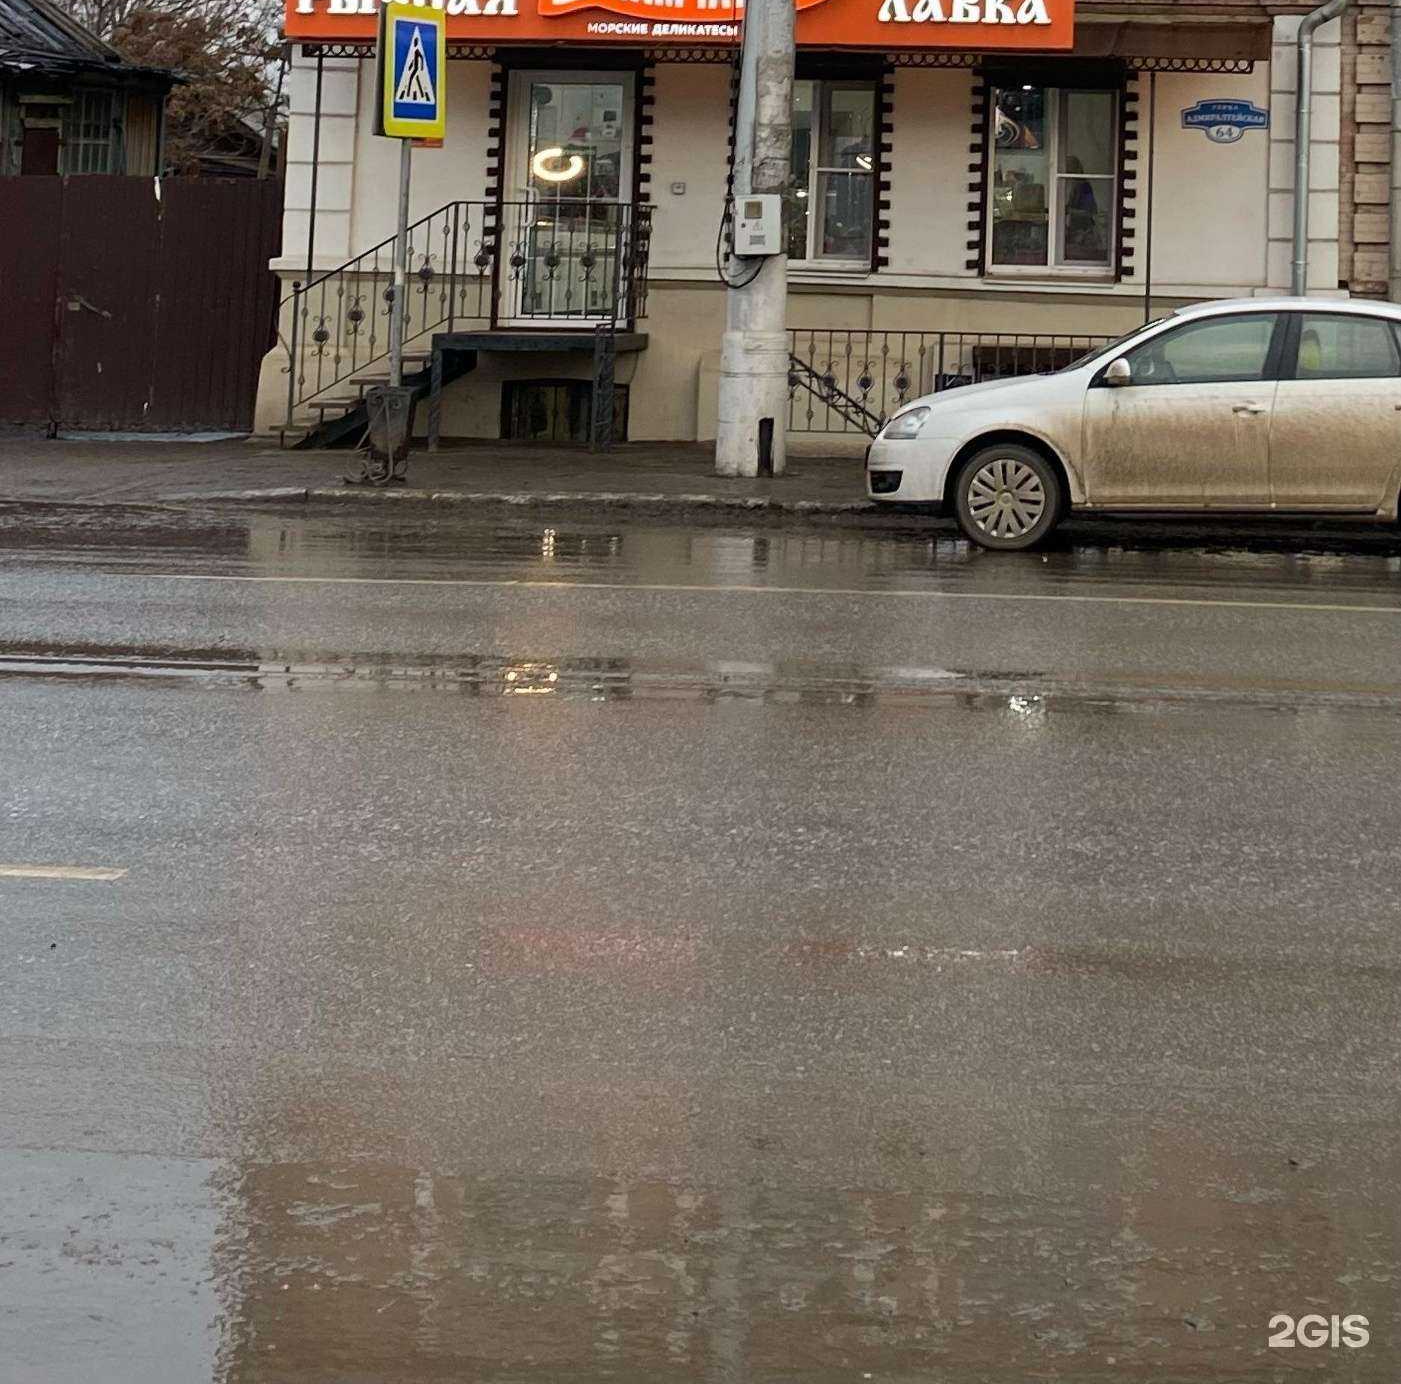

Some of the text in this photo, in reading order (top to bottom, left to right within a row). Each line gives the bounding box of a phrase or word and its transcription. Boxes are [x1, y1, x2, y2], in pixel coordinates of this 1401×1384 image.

[587, 22, 738, 36] МОРСКИЕ ДЕЛИКАТЕСЫ
[1216, 126, 1233, 137] 64
